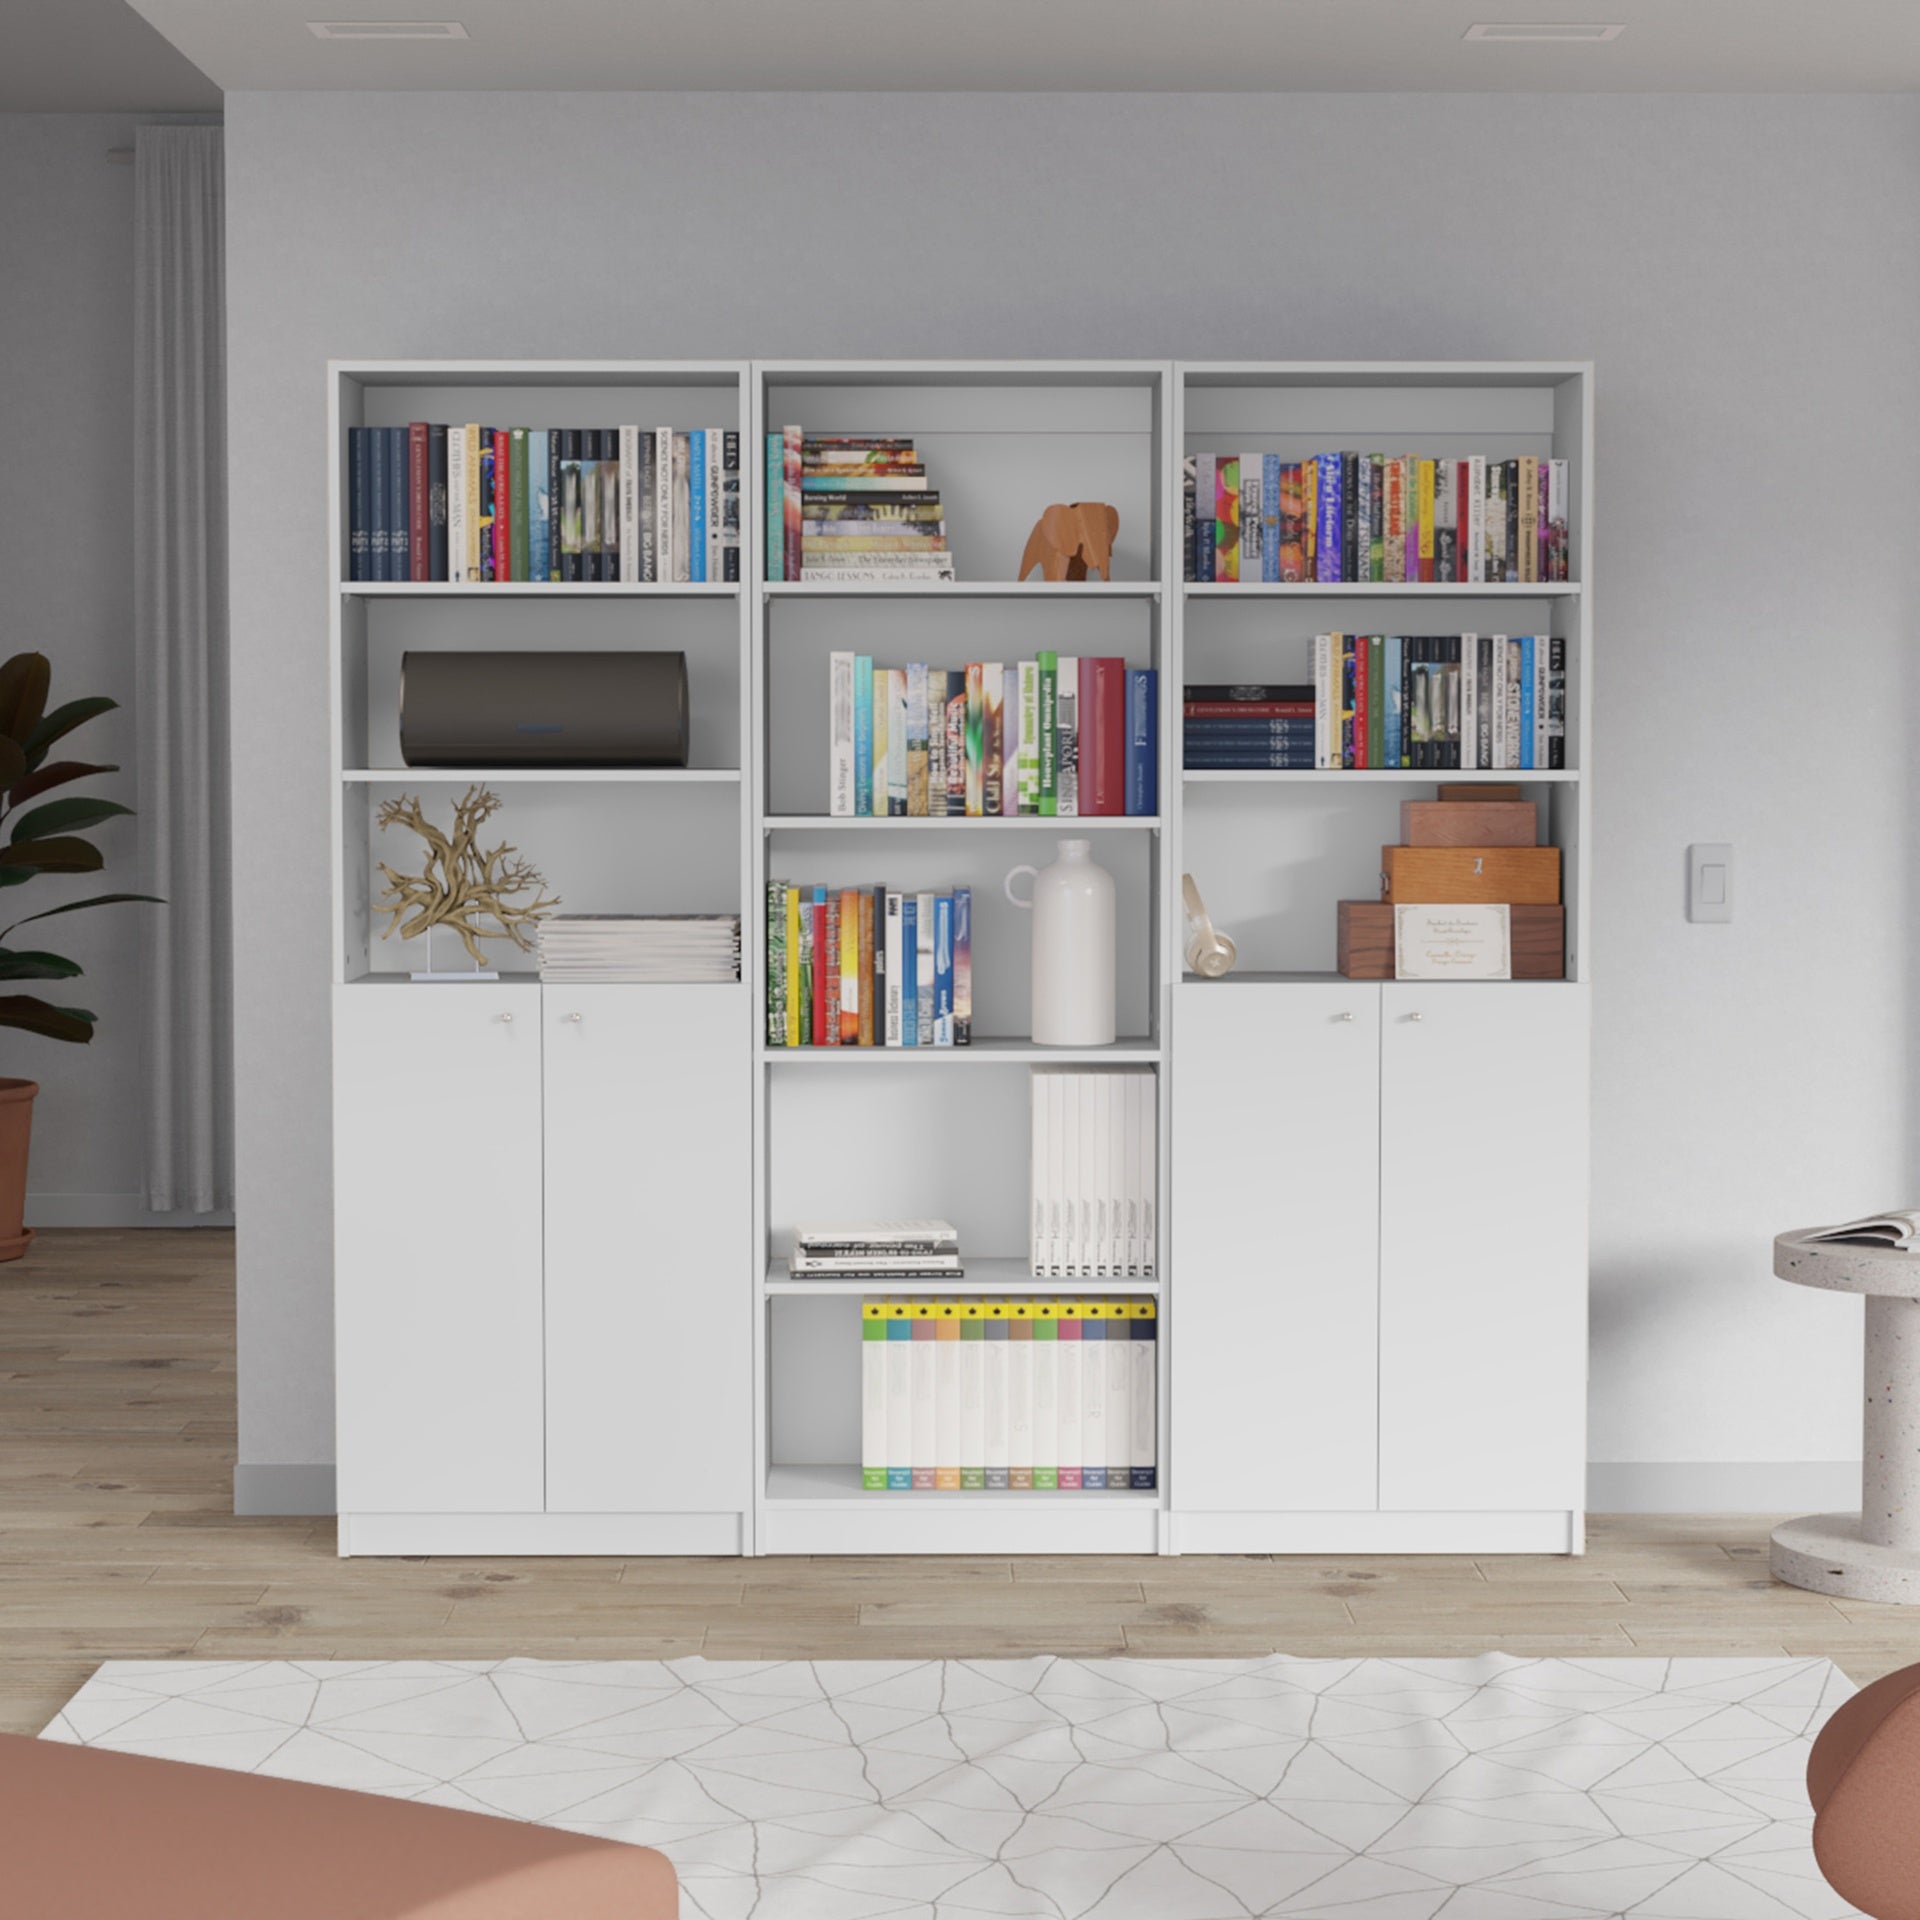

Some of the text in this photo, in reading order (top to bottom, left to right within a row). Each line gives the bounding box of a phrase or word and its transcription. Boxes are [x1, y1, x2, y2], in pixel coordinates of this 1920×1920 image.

[660, 431, 669, 462] SCIENCE
[660, 463, 669, 482] NOT
[660, 484, 669, 509] ONLY
[711, 464, 719, 527] GUNPOWDER
[1325, 497, 1337, 548] Lifeform
[929, 749, 938, 760] to
[1042, 732, 1054, 788] Houseplant
[929, 762, 938, 783] How
